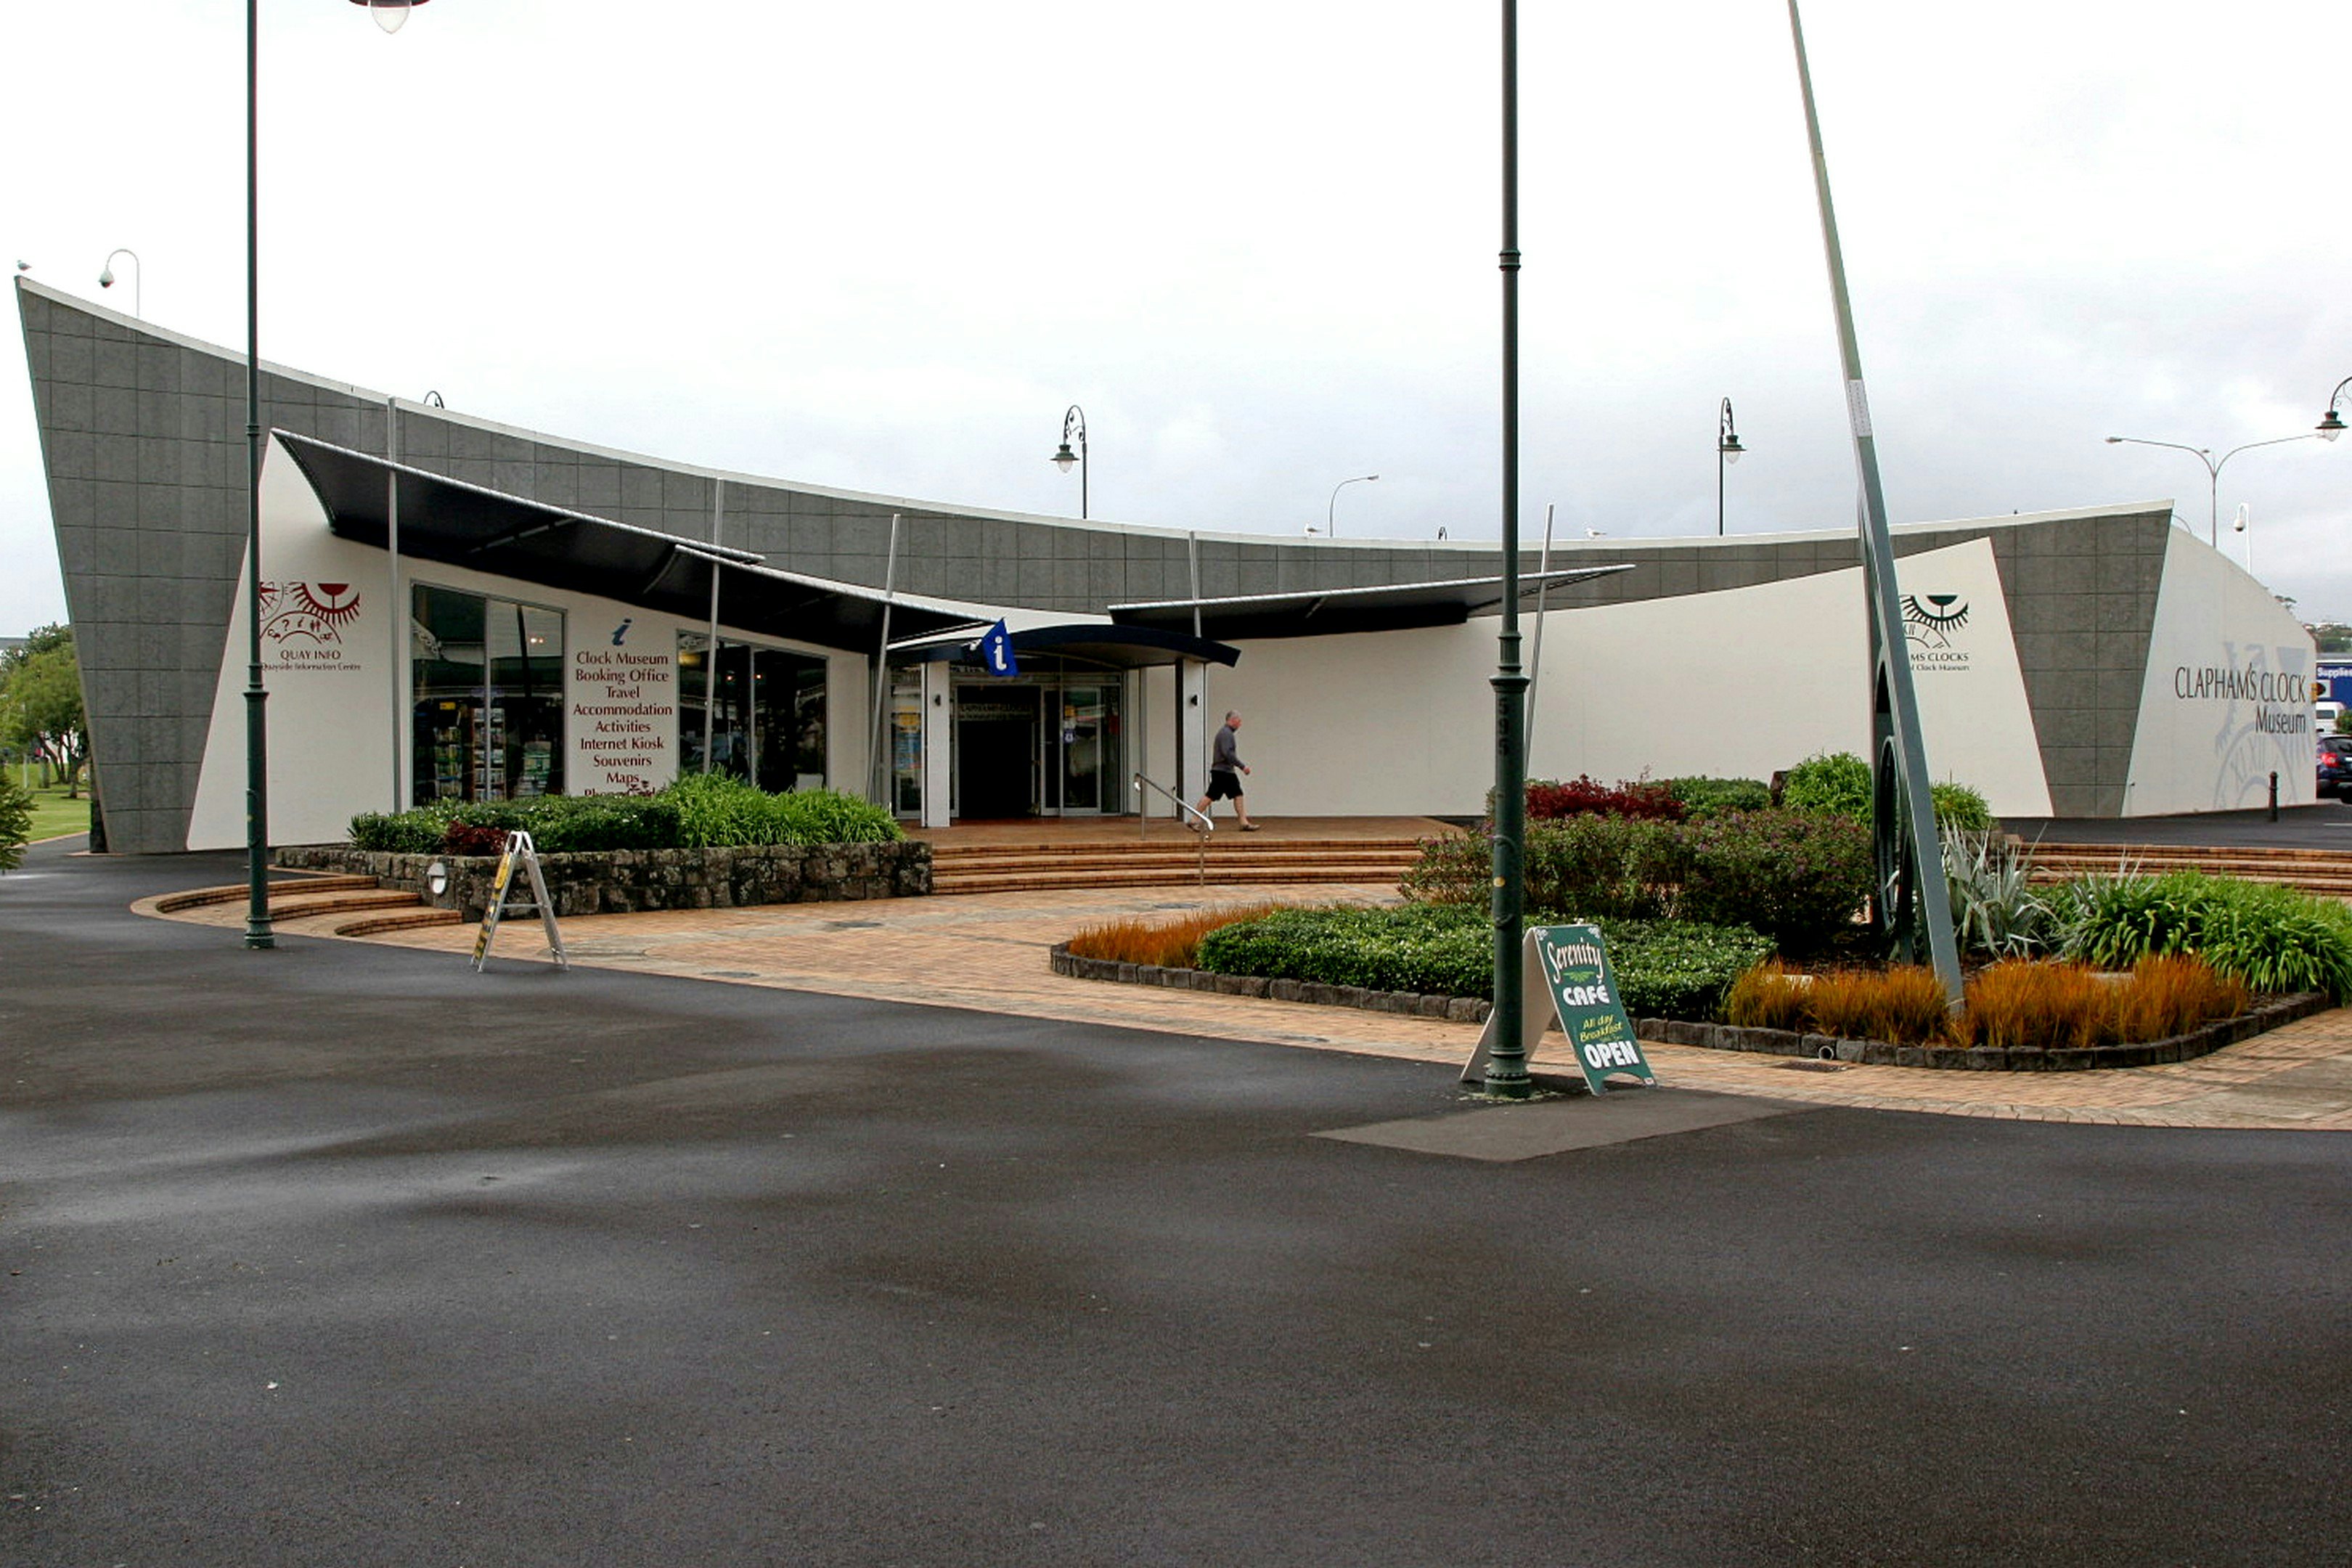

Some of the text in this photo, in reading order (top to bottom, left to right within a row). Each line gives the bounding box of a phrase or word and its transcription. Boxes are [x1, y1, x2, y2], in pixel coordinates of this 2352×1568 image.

[280, 650, 340, 661] QUAY INFO
[576, 652, 669, 664] Clock Museum
[1927, 653, 1969, 661] CLOCKS
[576, 669, 669, 685] Booking Office
[2175, 663, 2306, 703] CLAPHAM'S CLOCK
[605, 686, 640, 698] Travel
[573, 703, 673, 716] Accommodation
[595, 719, 651, 732] Activities
[2255, 706, 2306, 734] Museum
[581, 736, 664, 749] Internet Kiosk
[594, 754, 652, 767] Souvenirs
[606, 772, 640, 788] Maps
[1547, 937, 1604, 984] Serenity
[1583, 1014, 1613, 1029] All day
[1580, 1021, 1622, 1042] Breakfast
[1584, 1040, 1640, 1069] OPEN
